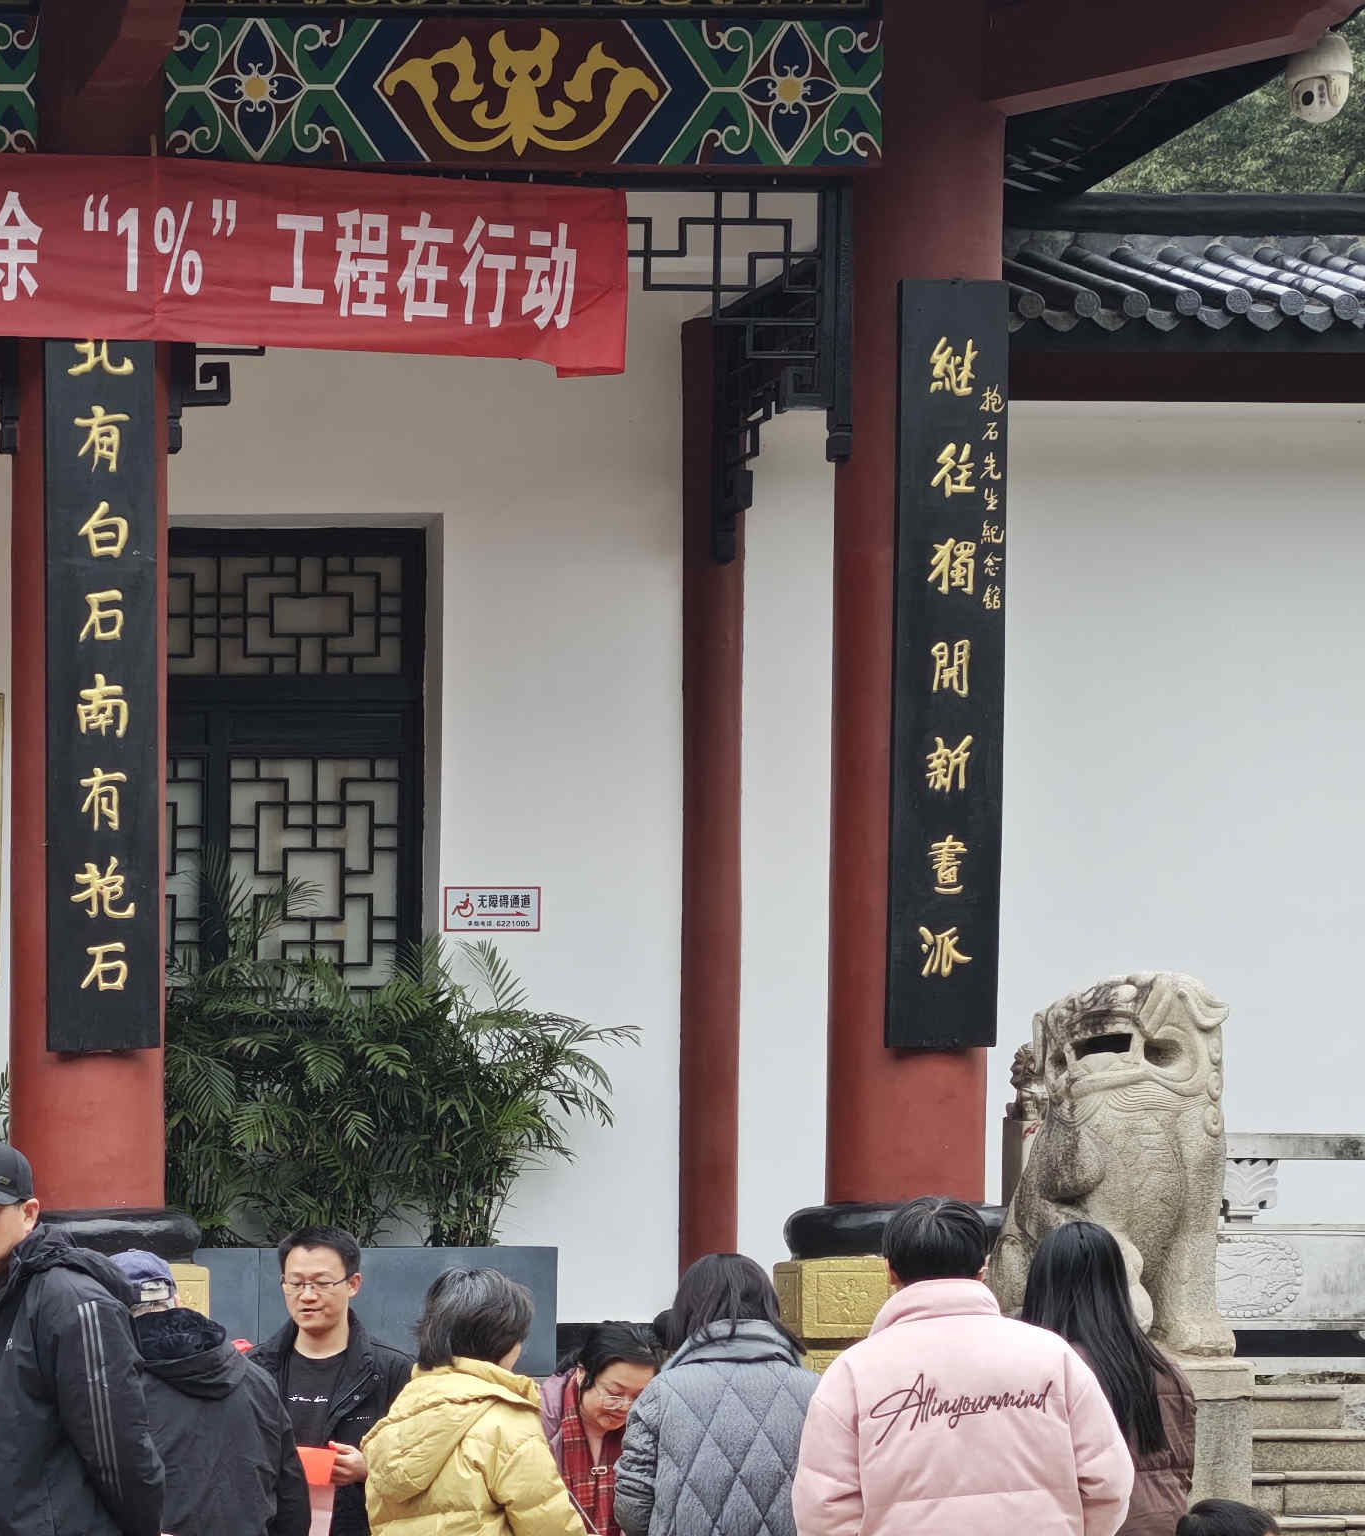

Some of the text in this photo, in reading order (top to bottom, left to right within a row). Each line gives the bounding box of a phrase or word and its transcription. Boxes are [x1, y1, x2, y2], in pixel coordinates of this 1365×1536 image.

[477, 894, 530, 908] 无障碍通道
